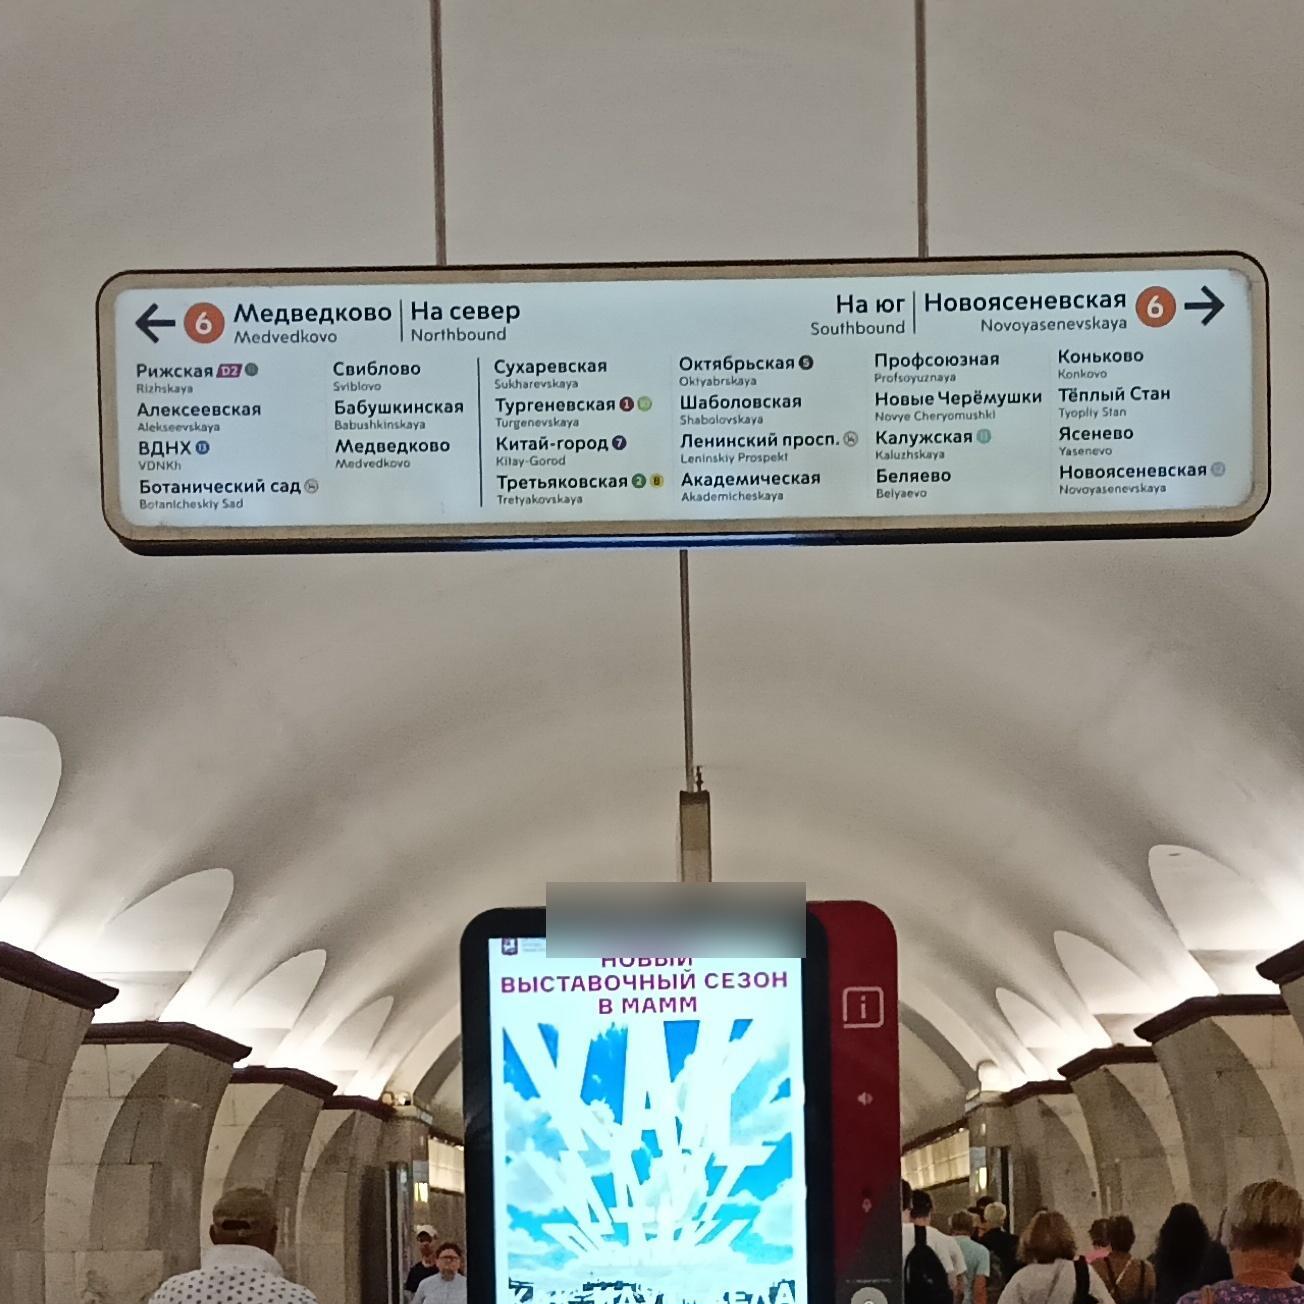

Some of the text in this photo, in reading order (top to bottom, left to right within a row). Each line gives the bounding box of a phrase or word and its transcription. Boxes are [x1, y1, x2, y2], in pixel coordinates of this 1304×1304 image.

[837, 295, 905, 313] На юг
[925, 293, 1125, 312] Новоясеневская
[1147, 297, 1164, 317] 6
[234, 304, 391, 325] Медведково
[412, 301, 520, 324] На север
[195, 314, 213, 333] 6
[811, 320, 905, 335] Southbound
[981, 316, 1127, 334] Novoyasenevskaya
[234, 329, 337, 343] Medvedkovo
[412, 327, 506, 341] Northbound
[875, 352, 999, 370] Профсоюзная
[1059, 349, 1143, 363] Коньково
[137, 364, 213, 377] Рижская
[221, 366, 238, 376] D2
[333, 361, 420, 376] Свиблово
[494, 359, 606, 377] Сухаревская
[680, 356, 794, 373] Октябрьская
[874, 370, 956, 384] Profsoyuznaya
[1058, 369, 1107, 379] Konkovo
[137, 383, 193, 394] Rizhskaya
[333, 381, 381, 391] Sviblovo
[495, 379, 578, 390] Sukharevskaya
[679, 376, 756, 387] Oktyabrskaya
[876, 390, 1041, 408] Новые Черёмушки
[1058, 386, 1170, 402] Тёплый Стан
[335, 400, 463, 418] Бабушкинская
[495, 398, 615, 416] Тургеневская
[681, 395, 801, 409] Шаболовская
[137, 403, 261, 416] Алексеевская
[875, 410, 995, 422] Novye Cheryomushki
[1103, 407, 1126, 416] Stan
[335, 417, 425, 430] Babushkinskaya
[496, 415, 579, 430] Turgenevskaya
[680, 414, 763, 425] Shabolovskaya
[138, 422, 220, 433] Alekseevskaya
[1059, 427, 1133, 440] Ясенево
[497, 436, 608, 453] Китай-город
[681, 433, 777, 448] Ленинский
[783, 435, 839, 449] просп.
[876, 431, 972, 447] Калужская
[139, 441, 191, 457] ВДНХ
[336, 439, 450, 455] Медведково
[1059, 447, 1112, 456] Yasenevo
[496, 456, 565, 468] Kitay-Gorod
[681, 452, 788, 464] Leninskiy Prospekt
[876, 450, 944, 460] Kaluzhskaya
[138, 461, 181, 471] VDNKh
[336, 458, 410, 468] Medvedkovo
[877, 469, 951, 483] Беляево
[1060, 465, 1206, 479] Новоясеневская
[140, 479, 264, 494] Ботанический
[271, 482, 301, 494] сад
[497, 475, 627, 492] Третьяковская
[682, 473, 820, 488] Академическая
[682, 491, 783, 502] Akademicheskaya
[877, 489, 927, 500] Belyaevo
[1060, 483, 1166, 496] Novoyasenevskaya
[140, 498, 243, 510] Botanicheskiy Sad
[497, 494, 582, 506] Tretyakovskaya
[501, 969, 788, 993] ВЫСТАВОЧНЫЙ СЕЗОН
[599, 996, 697, 1014] В МАММ
